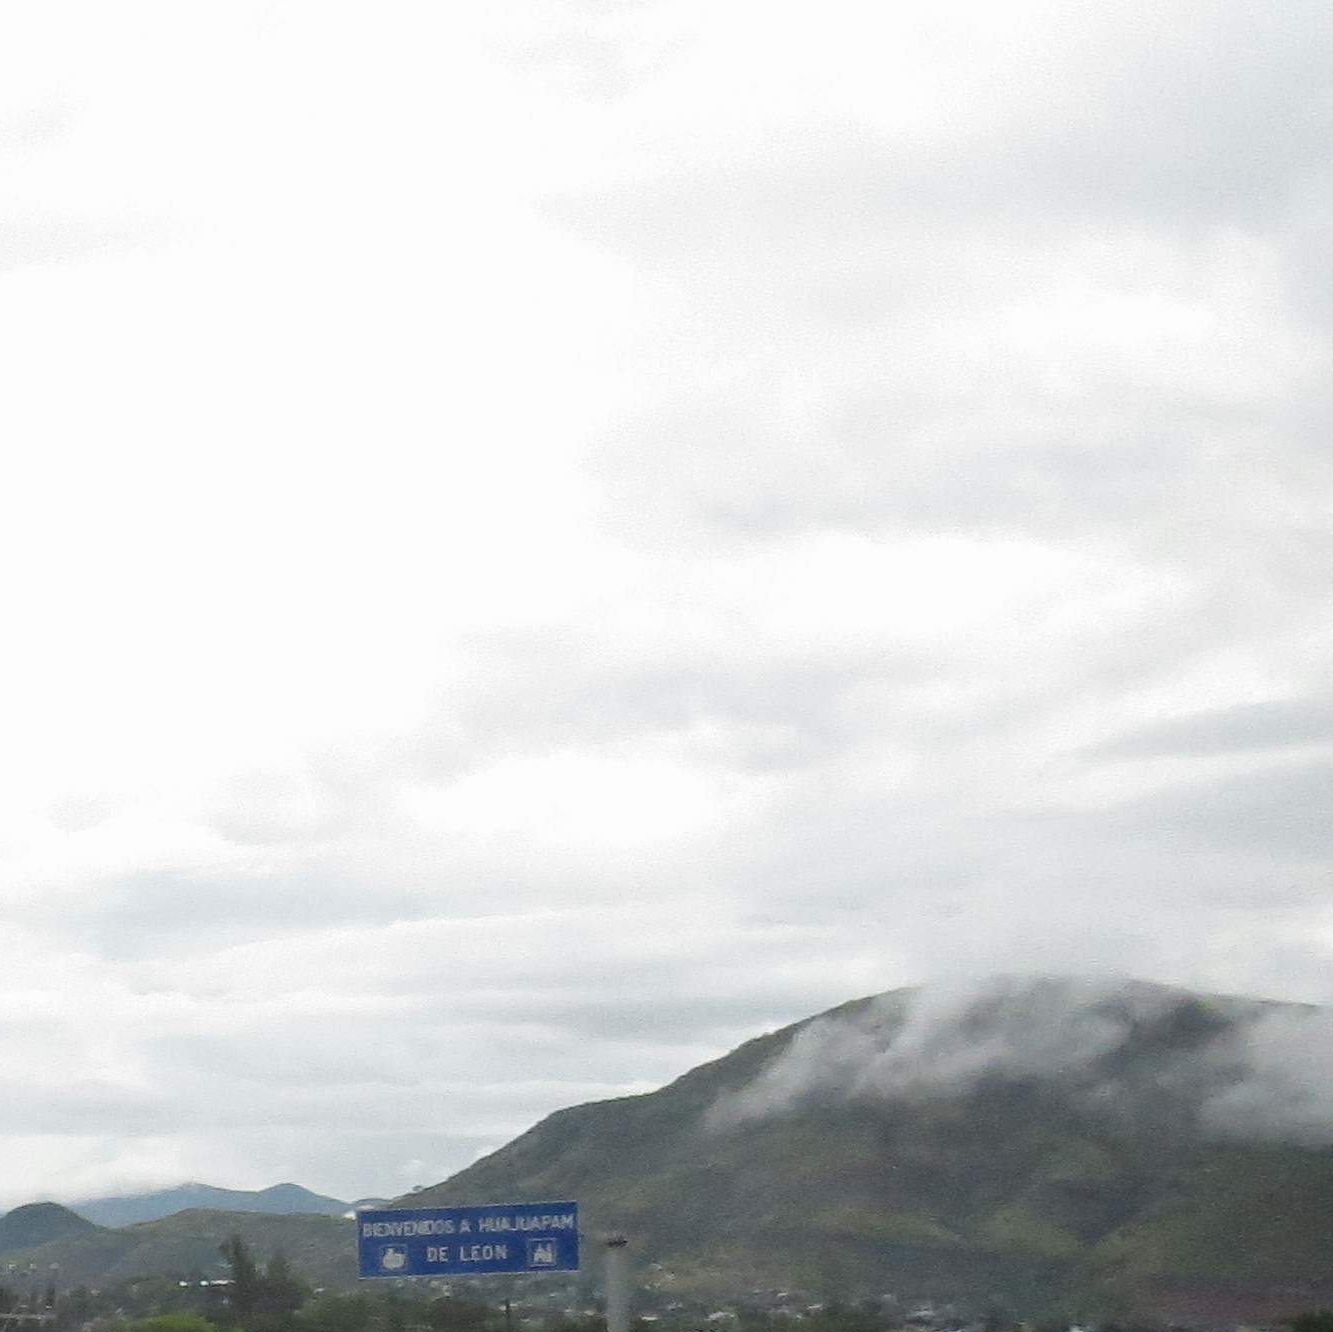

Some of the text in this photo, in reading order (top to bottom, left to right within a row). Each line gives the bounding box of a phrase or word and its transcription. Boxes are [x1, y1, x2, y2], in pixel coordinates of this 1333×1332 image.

[362, 1219, 454, 1237] BIENVENIDOS
[459, 1218, 471, 1233] A
[426, 1244, 508, 1263] DE LEON
